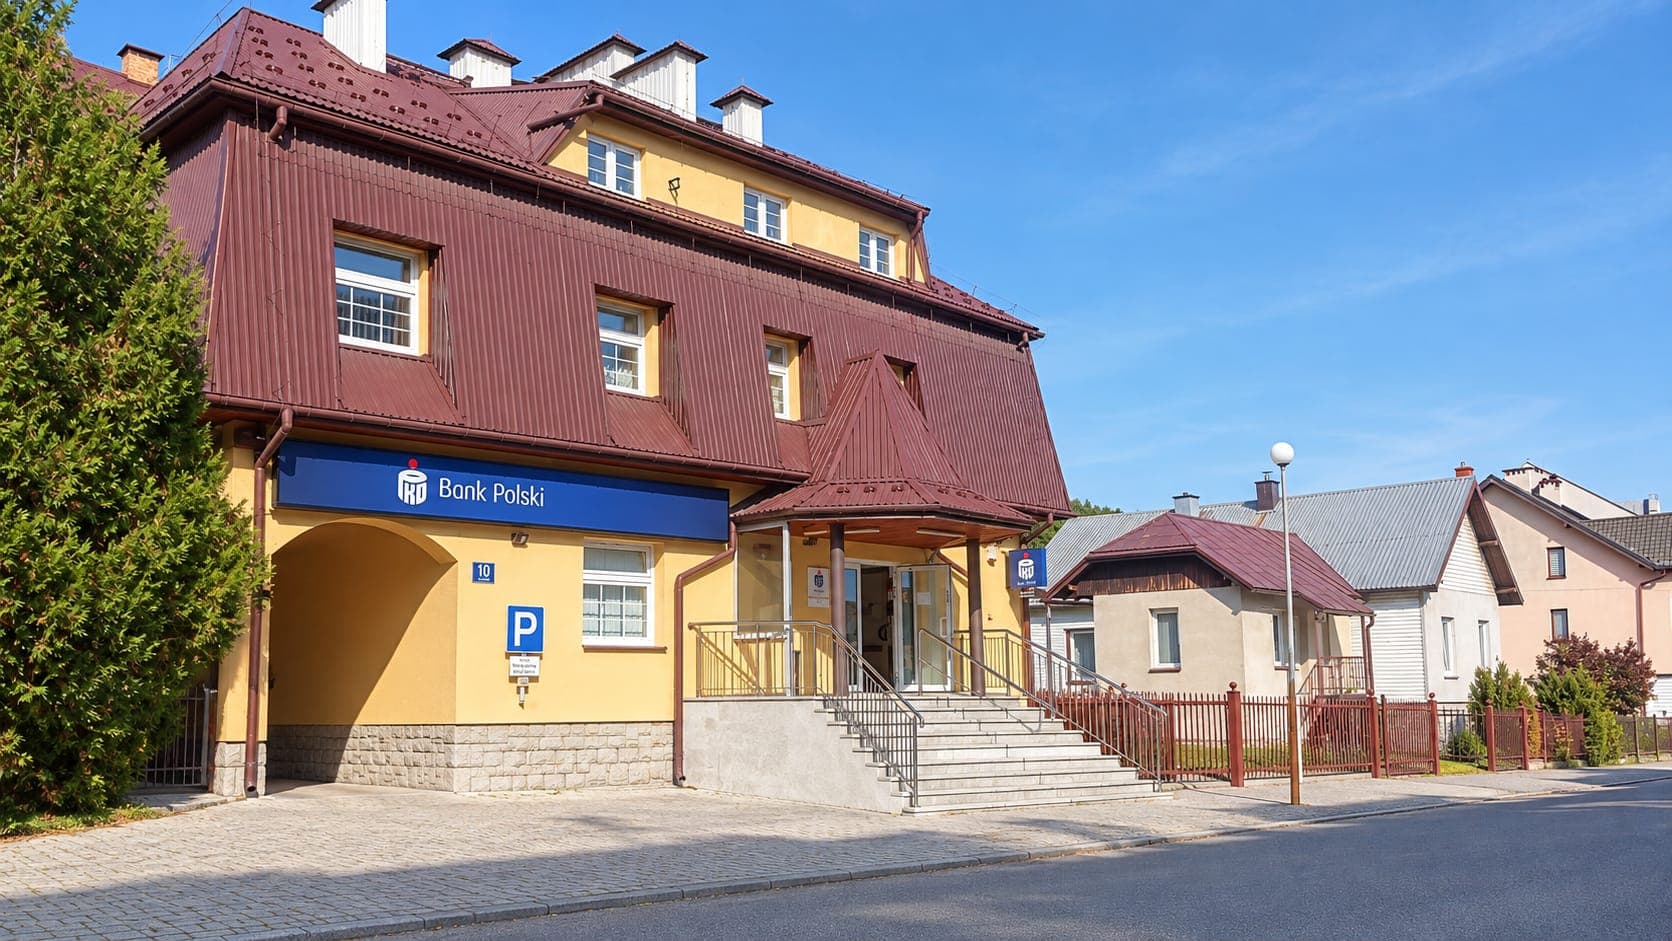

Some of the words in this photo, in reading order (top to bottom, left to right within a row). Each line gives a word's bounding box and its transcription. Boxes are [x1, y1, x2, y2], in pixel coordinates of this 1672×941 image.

[439, 477, 487, 502] Bank
[493, 482, 544, 507] Polski
[478, 564, 490, 577] 10
[513, 611, 538, 647] P
